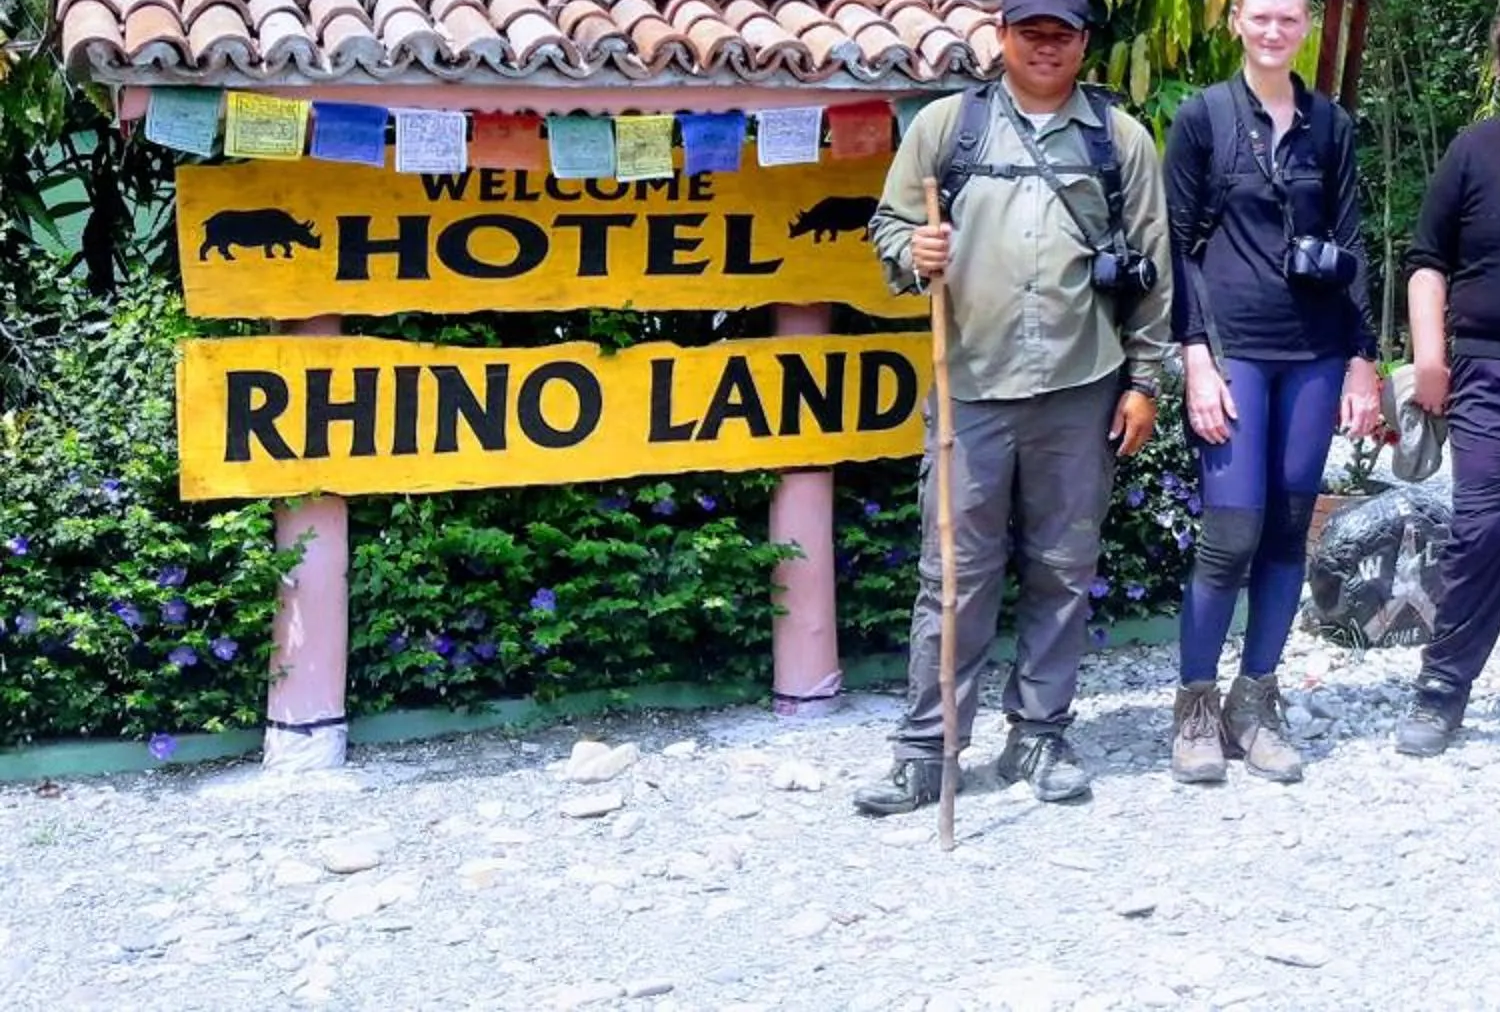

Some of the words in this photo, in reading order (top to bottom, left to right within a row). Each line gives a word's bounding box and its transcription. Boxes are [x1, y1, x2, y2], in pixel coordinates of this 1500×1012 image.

[420, 168, 715, 201] WELCOME
[337, 213, 783, 280] HOTEL
[224, 361, 602, 462] RHINO
[649, 349, 918, 443] LAND
